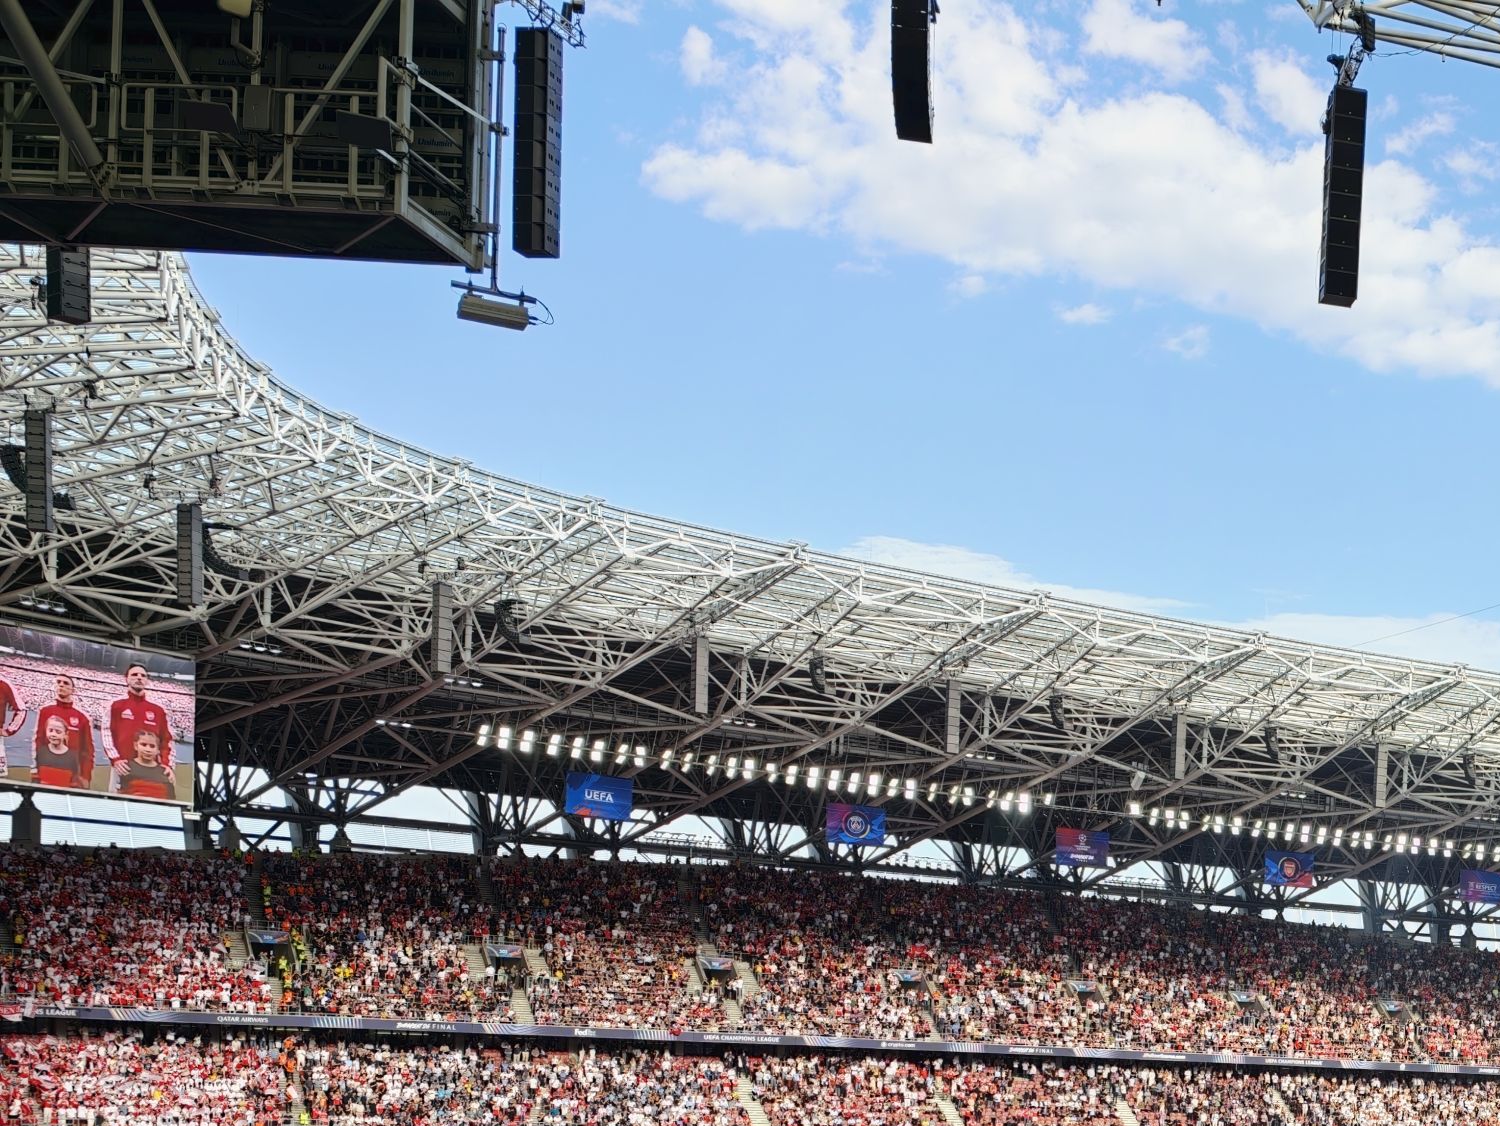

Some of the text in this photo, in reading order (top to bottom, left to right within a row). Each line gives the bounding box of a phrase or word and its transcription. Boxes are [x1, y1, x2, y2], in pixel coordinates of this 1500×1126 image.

[585, 790, 613, 803] UEFA
[46, 1009, 77, 1017] LEAGUE
[720, 1035, 755, 1043] CHAMPIONS
[755, 1036, 780, 1044] LEAGUE
